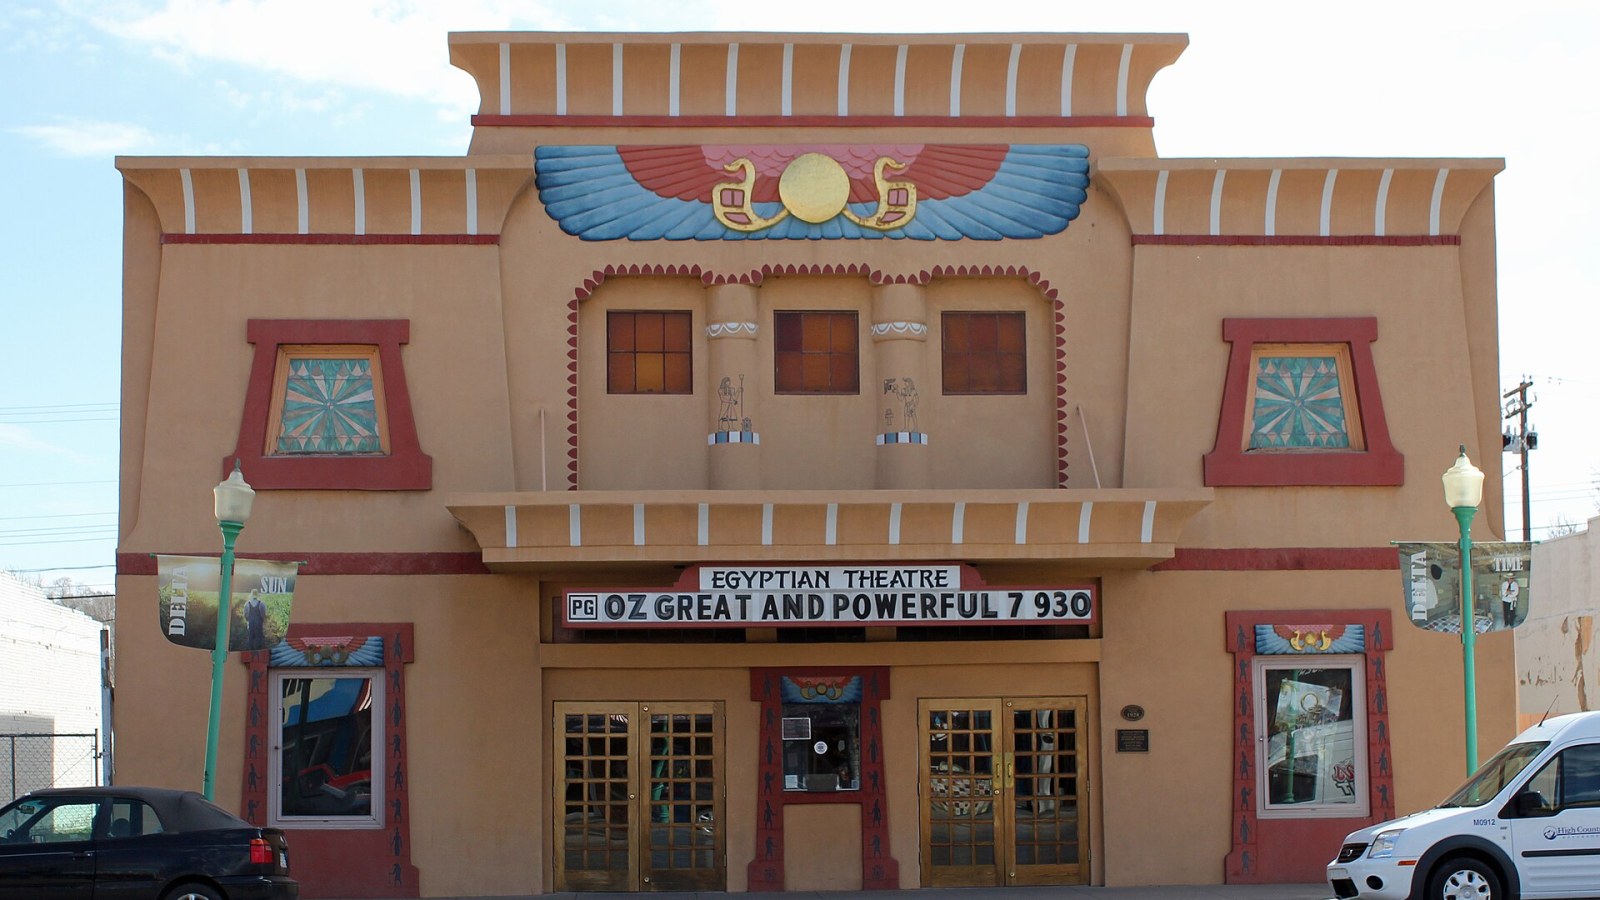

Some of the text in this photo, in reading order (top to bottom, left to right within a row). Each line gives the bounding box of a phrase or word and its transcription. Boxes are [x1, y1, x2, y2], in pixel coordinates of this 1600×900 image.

[1494, 556, 1523, 571] TIME
[261, 577, 287, 593] SUN
[711, 569, 949, 590] EGYPTIAN THEATRE
[1411, 550, 1427, 620] DELTA
[169, 566, 187, 636] DELTA
[572, 599, 594, 616] PG
[604, 591, 1092, 621] OZ GREAT AND POWERFUL 7 930
